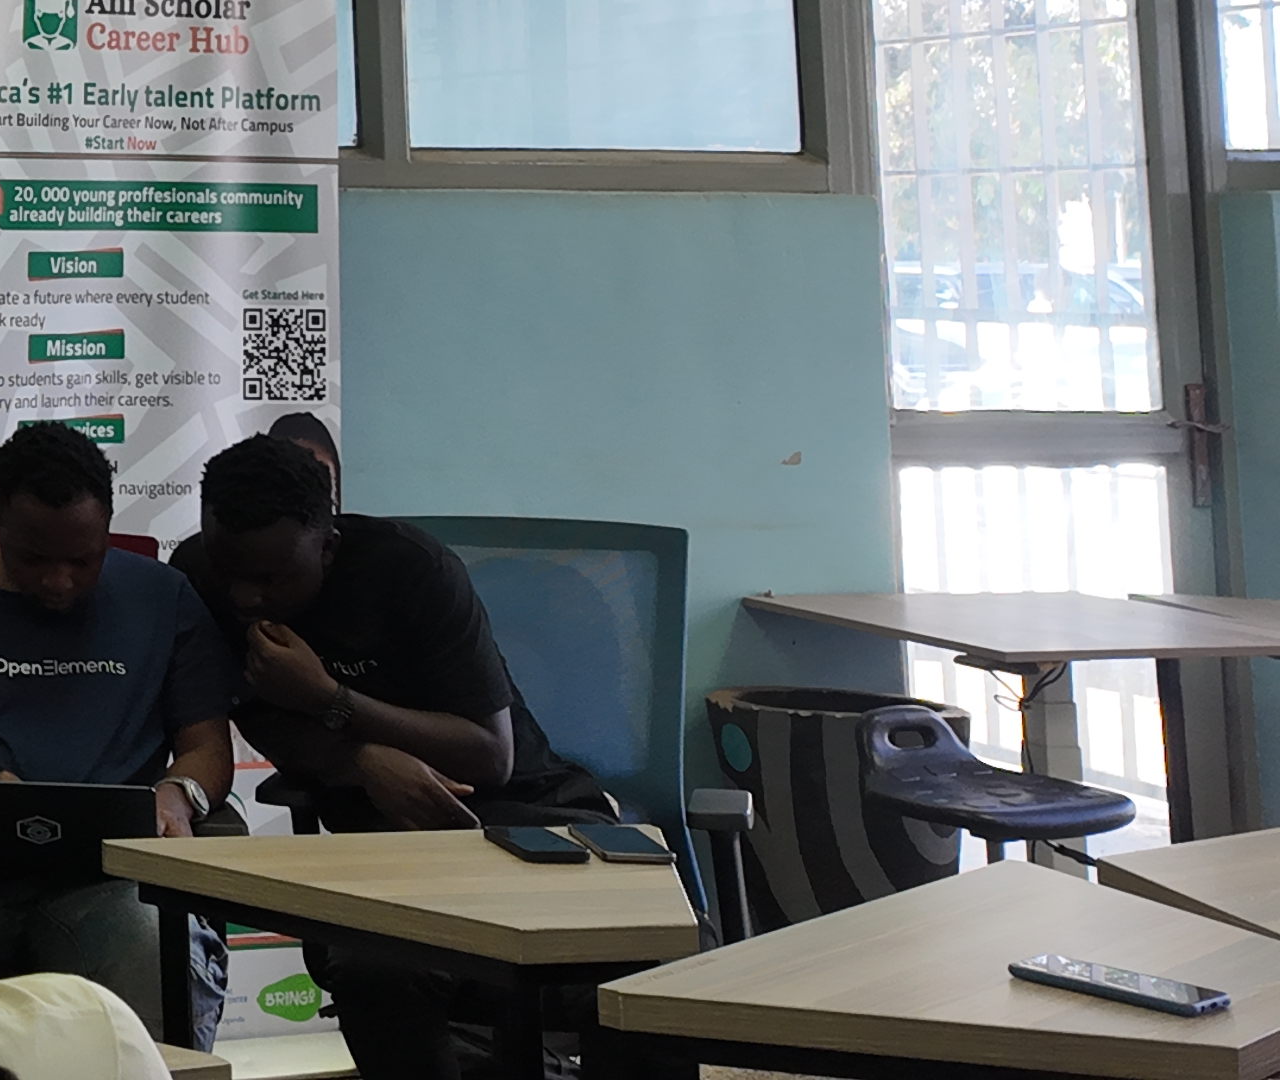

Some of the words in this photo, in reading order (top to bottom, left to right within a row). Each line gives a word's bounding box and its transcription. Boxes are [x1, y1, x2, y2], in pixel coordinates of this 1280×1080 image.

[86, 22, 181, 52] Career
[189, 25, 250, 55] Hub
[47, 82, 73, 105] #1
[84, 83, 139, 113] Early
[144, 85, 214, 109] talent
[222, 86, 321, 112] Platform
[17, 113, 69, 131] Building
[72, 114, 100, 128] Your
[103, 114, 142, 129] Career
[145, 116, 177, 131] Now,
[181, 117, 206, 131] Not
[209, 117, 238, 132] After
[241, 118, 294, 136] Campus
[85, 135, 125, 150] #Start
[127, 136, 157, 151] Now
[14, 186, 37, 204] 20,
[41, 186, 70, 203] 000
[72, 188, 116, 207] young
[118, 187, 217, 207] proffesionals
[220, 189, 304, 210] community
[9, 206, 65, 226] already
[68, 206, 124, 226] building
[127, 207, 163, 223] their
[166, 210, 223, 224] careers
[50, 256, 97, 274] Vision
[22, 294, 31, 305] a
[34, 290, 72, 305] future
[74, 291, 113, 304] where
[116, 292, 153, 308] every
[156, 290, 210, 305] student
[242, 289, 259, 300] Get
[261, 289, 299, 300] Started
[301, 290, 325, 300] Here
[9, 313, 46, 330] ready
[46, 338, 106, 357] Mission
[8, 372, 64, 387] students
[66, 373, 92, 390] gain
[95, 370, 132, 386] skills,
[135, 371, 159, 389] get
[161, 370, 205, 386] visible
[208, 372, 221, 385] to
[15, 393, 38, 408] and
[41, 393, 81, 408] launch
[84, 392, 115, 407] their
[117, 394, 174, 408] careers.
[118, 480, 193, 500] navigation
